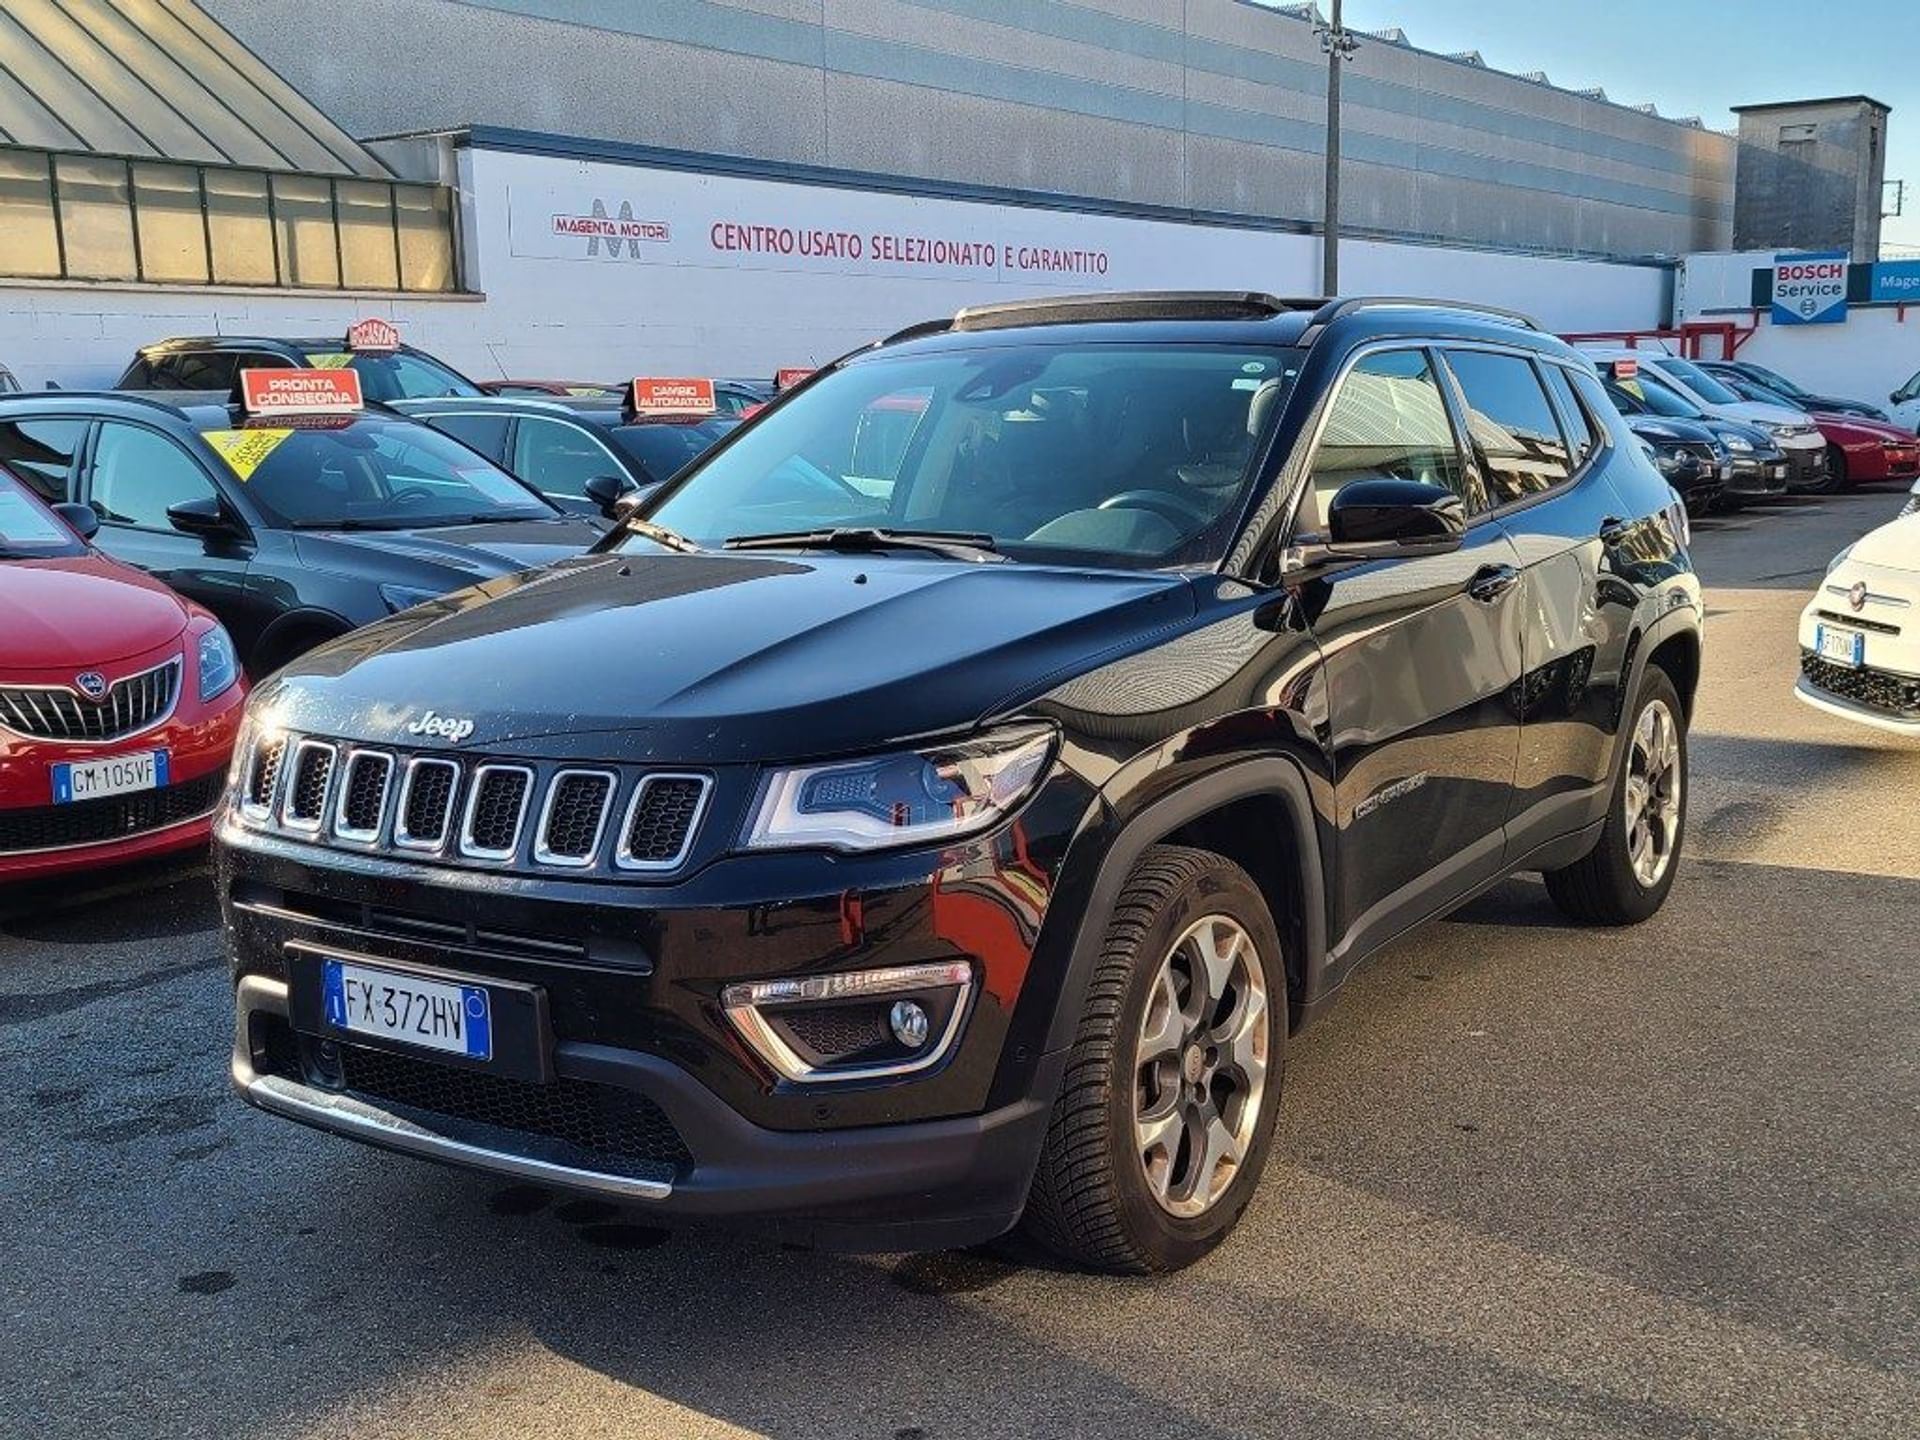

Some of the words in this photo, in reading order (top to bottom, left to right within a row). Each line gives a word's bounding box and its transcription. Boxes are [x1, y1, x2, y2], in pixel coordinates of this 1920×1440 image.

[555, 218, 616, 235] MAGENTA
[620, 223, 669, 239] MOTORI
[710, 223, 794, 254] CENTRO
[799, 229, 862, 260] USATO
[871, 235, 996, 268] SELEZIONATO
[1004, 246, 1013, 268] E
[1018, 247, 1108, 274] GARANTITO
[1777, 264, 1842, 280] BOSCH
[1776, 282, 1842, 297] Service
[269, 379, 336, 391] PRONTA
[652, 386, 697, 396] CAMBIO
[256, 392, 353, 406] CONSEGNA
[640, 397, 711, 407] AUTOMATICO
[407, 710, 475, 744] Jeep
[345, 978, 375, 1024] FX
[382, 986, 462, 1040] 372HV
